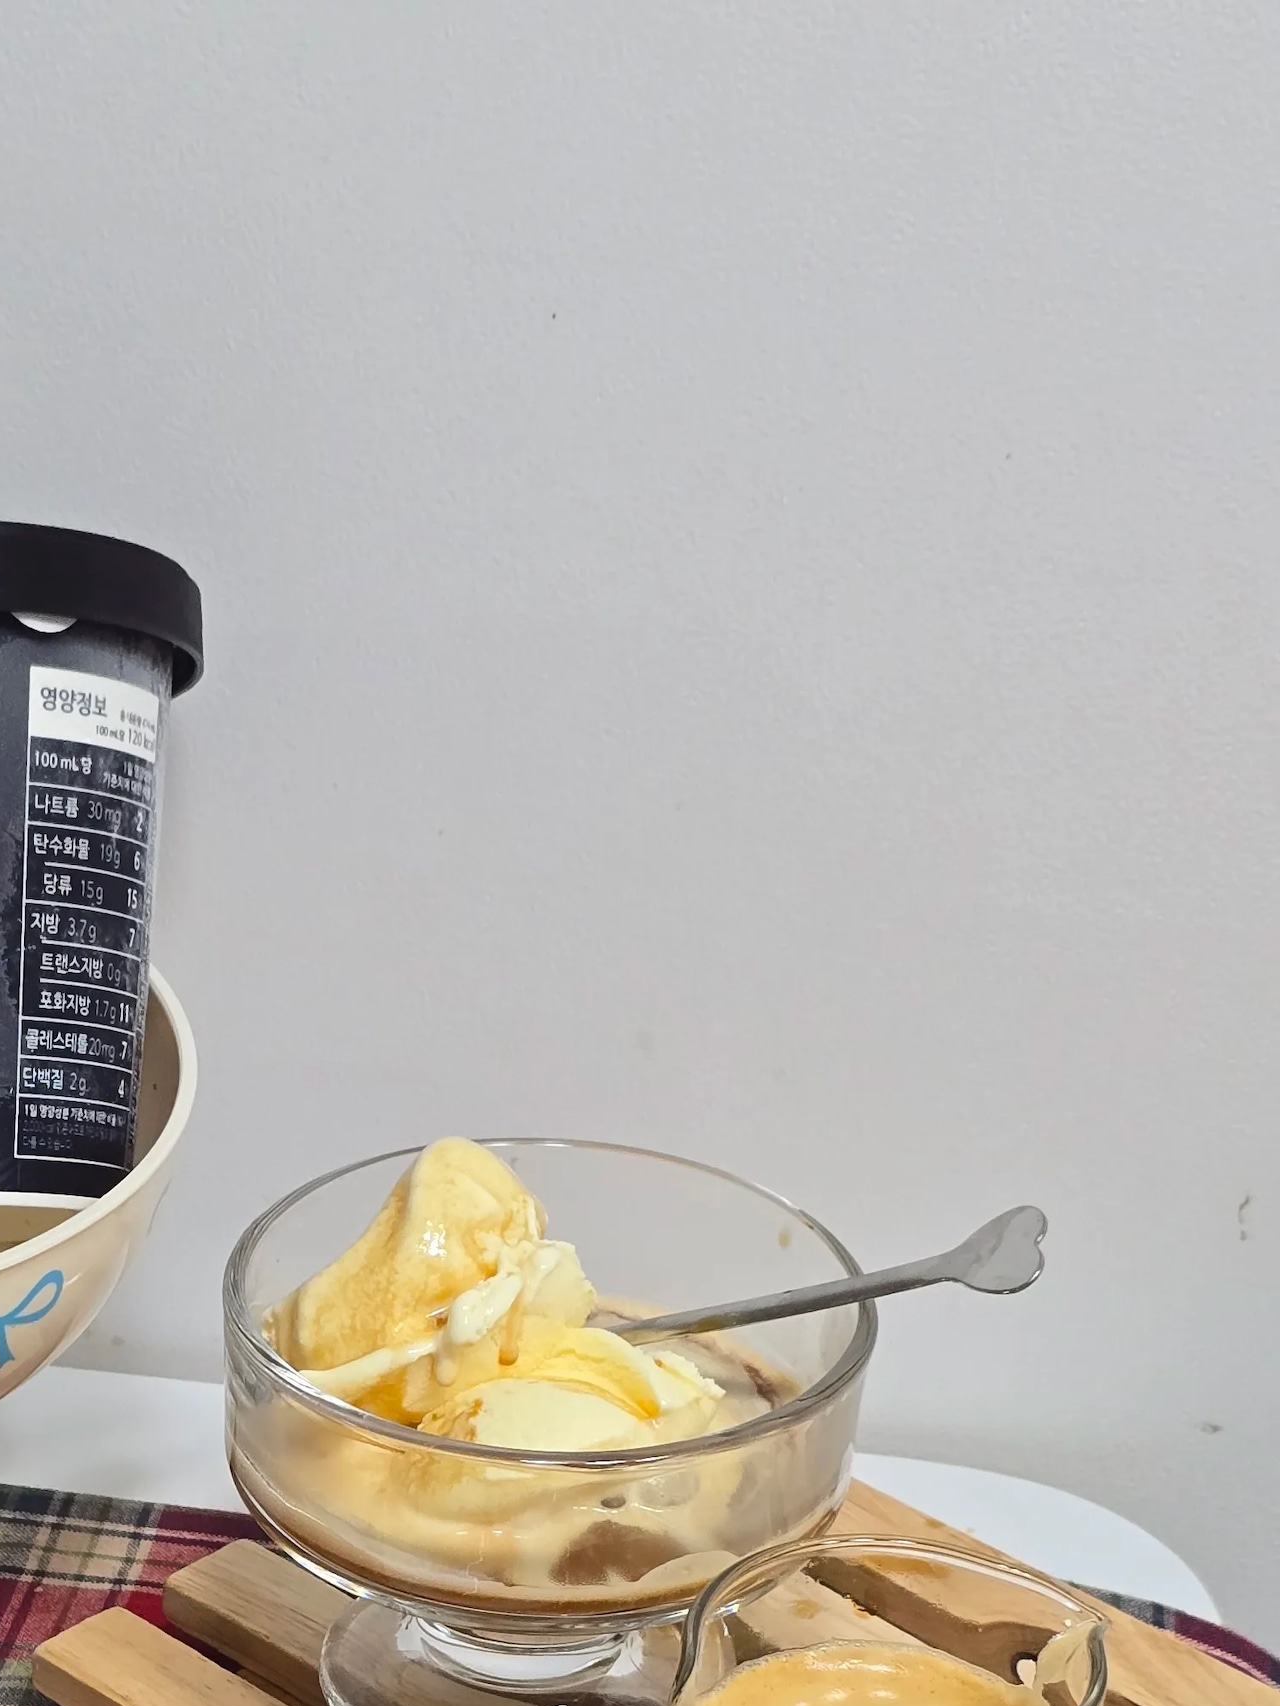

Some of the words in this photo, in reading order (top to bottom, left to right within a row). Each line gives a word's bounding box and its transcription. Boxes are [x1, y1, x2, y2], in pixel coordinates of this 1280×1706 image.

[40, 687, 109, 717] 영양정보
[128, 728, 142, 746] 120
[35, 750, 58, 769] 100
[34, 793, 79, 819] 나트륨
[33, 833, 90, 860] 탄수화물
[133, 851, 141, 871] 6
[43, 873, 73, 897] 당류
[127, 888, 138, 909] 15
[30, 912, 61, 935] 지방
[129, 928, 136, 948] 7
[40, 952, 103, 979] 트랜스지방
[39, 989, 91, 1016] 포화지방
[119, 1002, 129, 1023] 11
[25, 1028, 88, 1055] 콜레스테롤
[23, 1066, 64, 1090] 단백질
